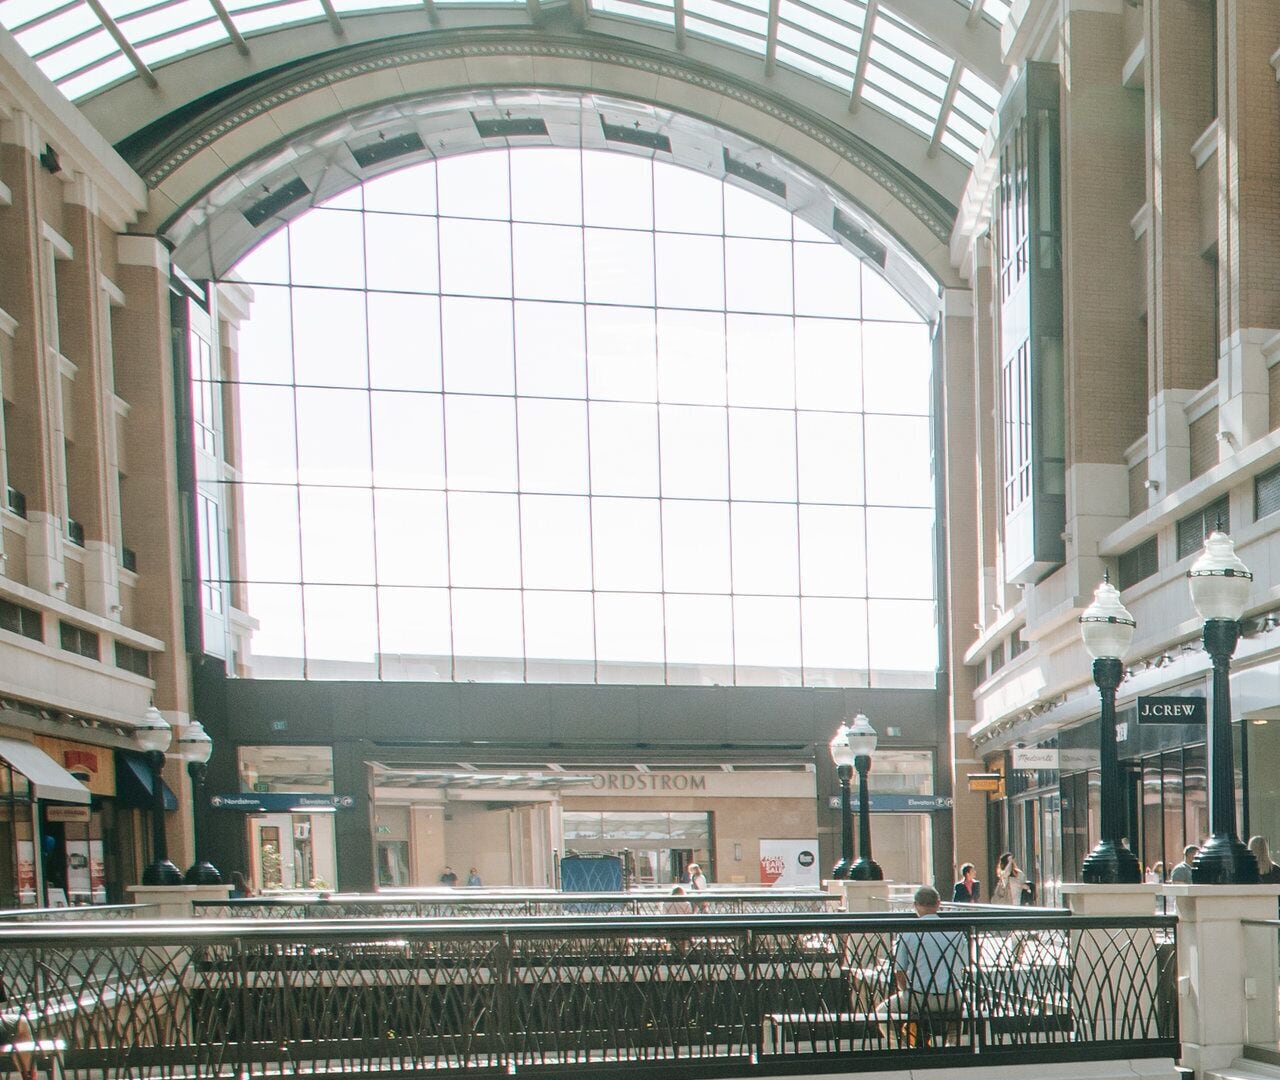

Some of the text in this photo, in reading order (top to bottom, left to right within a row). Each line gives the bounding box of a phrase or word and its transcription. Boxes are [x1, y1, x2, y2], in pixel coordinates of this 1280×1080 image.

[1141, 704, 1195, 716] J.CREW
[574, 774, 706, 790] ORDSTROM
[908, 797, 935, 806] Elevators
